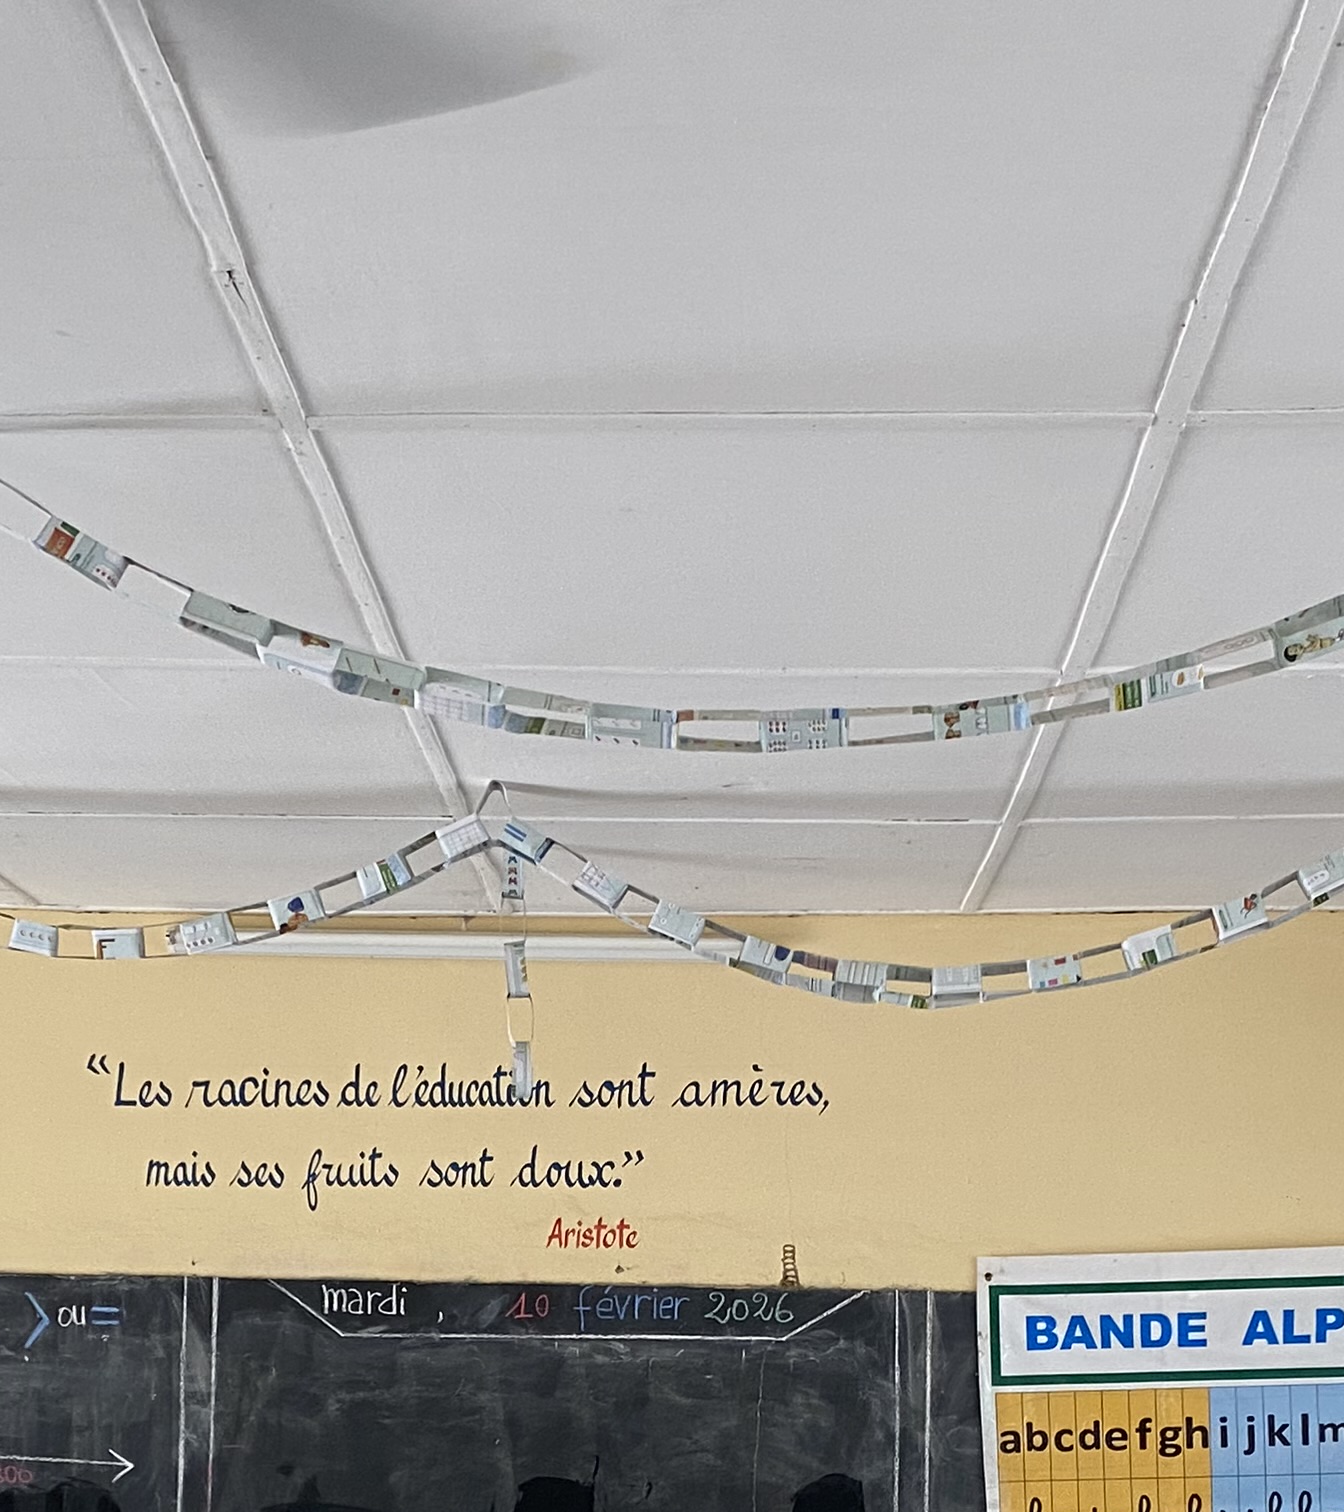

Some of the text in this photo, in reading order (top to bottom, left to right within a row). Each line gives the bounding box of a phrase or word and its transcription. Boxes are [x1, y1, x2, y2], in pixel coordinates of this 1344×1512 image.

[185, 1067, 329, 1108] racines
[337, 1063, 381, 1108] de
[569, 1062, 656, 1109] sont
[671, 1063, 830, 1115] amères,
[146, 1151, 216, 1187] mais
[229, 1160, 285, 1188] ses
[301, 1147, 399, 1211] fruits
[419, 1148, 495, 1188] sont
[546, 1216, 640, 1249] Aristote
[57, 1305, 85, 1328] ou
[505, 1293, 550, 1320] 10
[572, 1285, 687, 1331] février
[705, 1292, 795, 1324] 2026
[1025, 1311, 1208, 1351] BANDE
